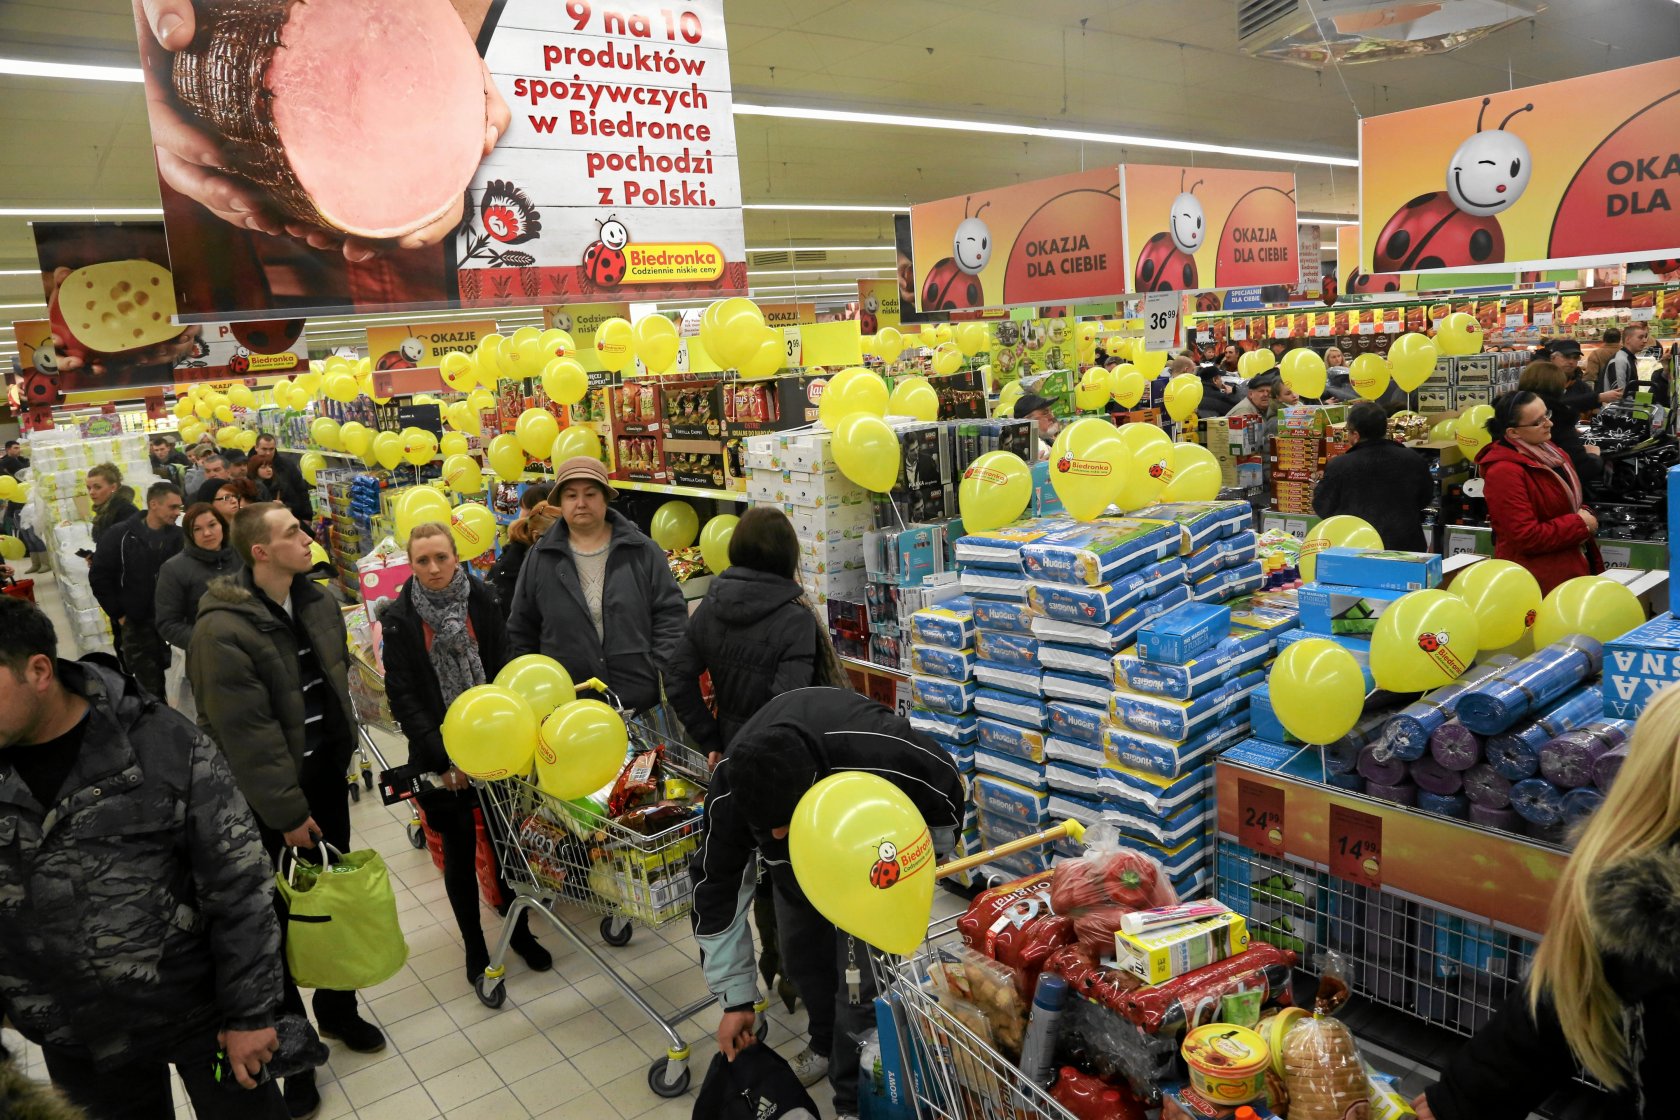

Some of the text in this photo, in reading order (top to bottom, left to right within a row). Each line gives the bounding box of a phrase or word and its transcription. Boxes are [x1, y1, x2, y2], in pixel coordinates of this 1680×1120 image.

[565, 0, 702, 45] 9 na 10
[543, 42, 706, 77] produktów
[514, 74, 708, 114] spożywczych
[528, 110, 711, 142] w Biedronce
[587, 146, 714, 178] pochodzi
[598, 180, 716, 207] z Polski.
[1606, 188, 1672, 217] DLA
[1025, 234, 1090, 258] OKAZJA
[1233, 227, 1278, 244] OKAZJA
[630, 249, 716, 266] Biedronka
[1027, 253, 1108, 278] DLA CIEBIE
[1234, 246, 1289, 263] DLA CIEBIE
[631, 265, 717, 275] Codziennie niskie ceny
[431, 331, 476, 343] OKAZJE
[251, 355, 294, 364] Biedronka
[1072, 462, 1109, 471] Biedronka
